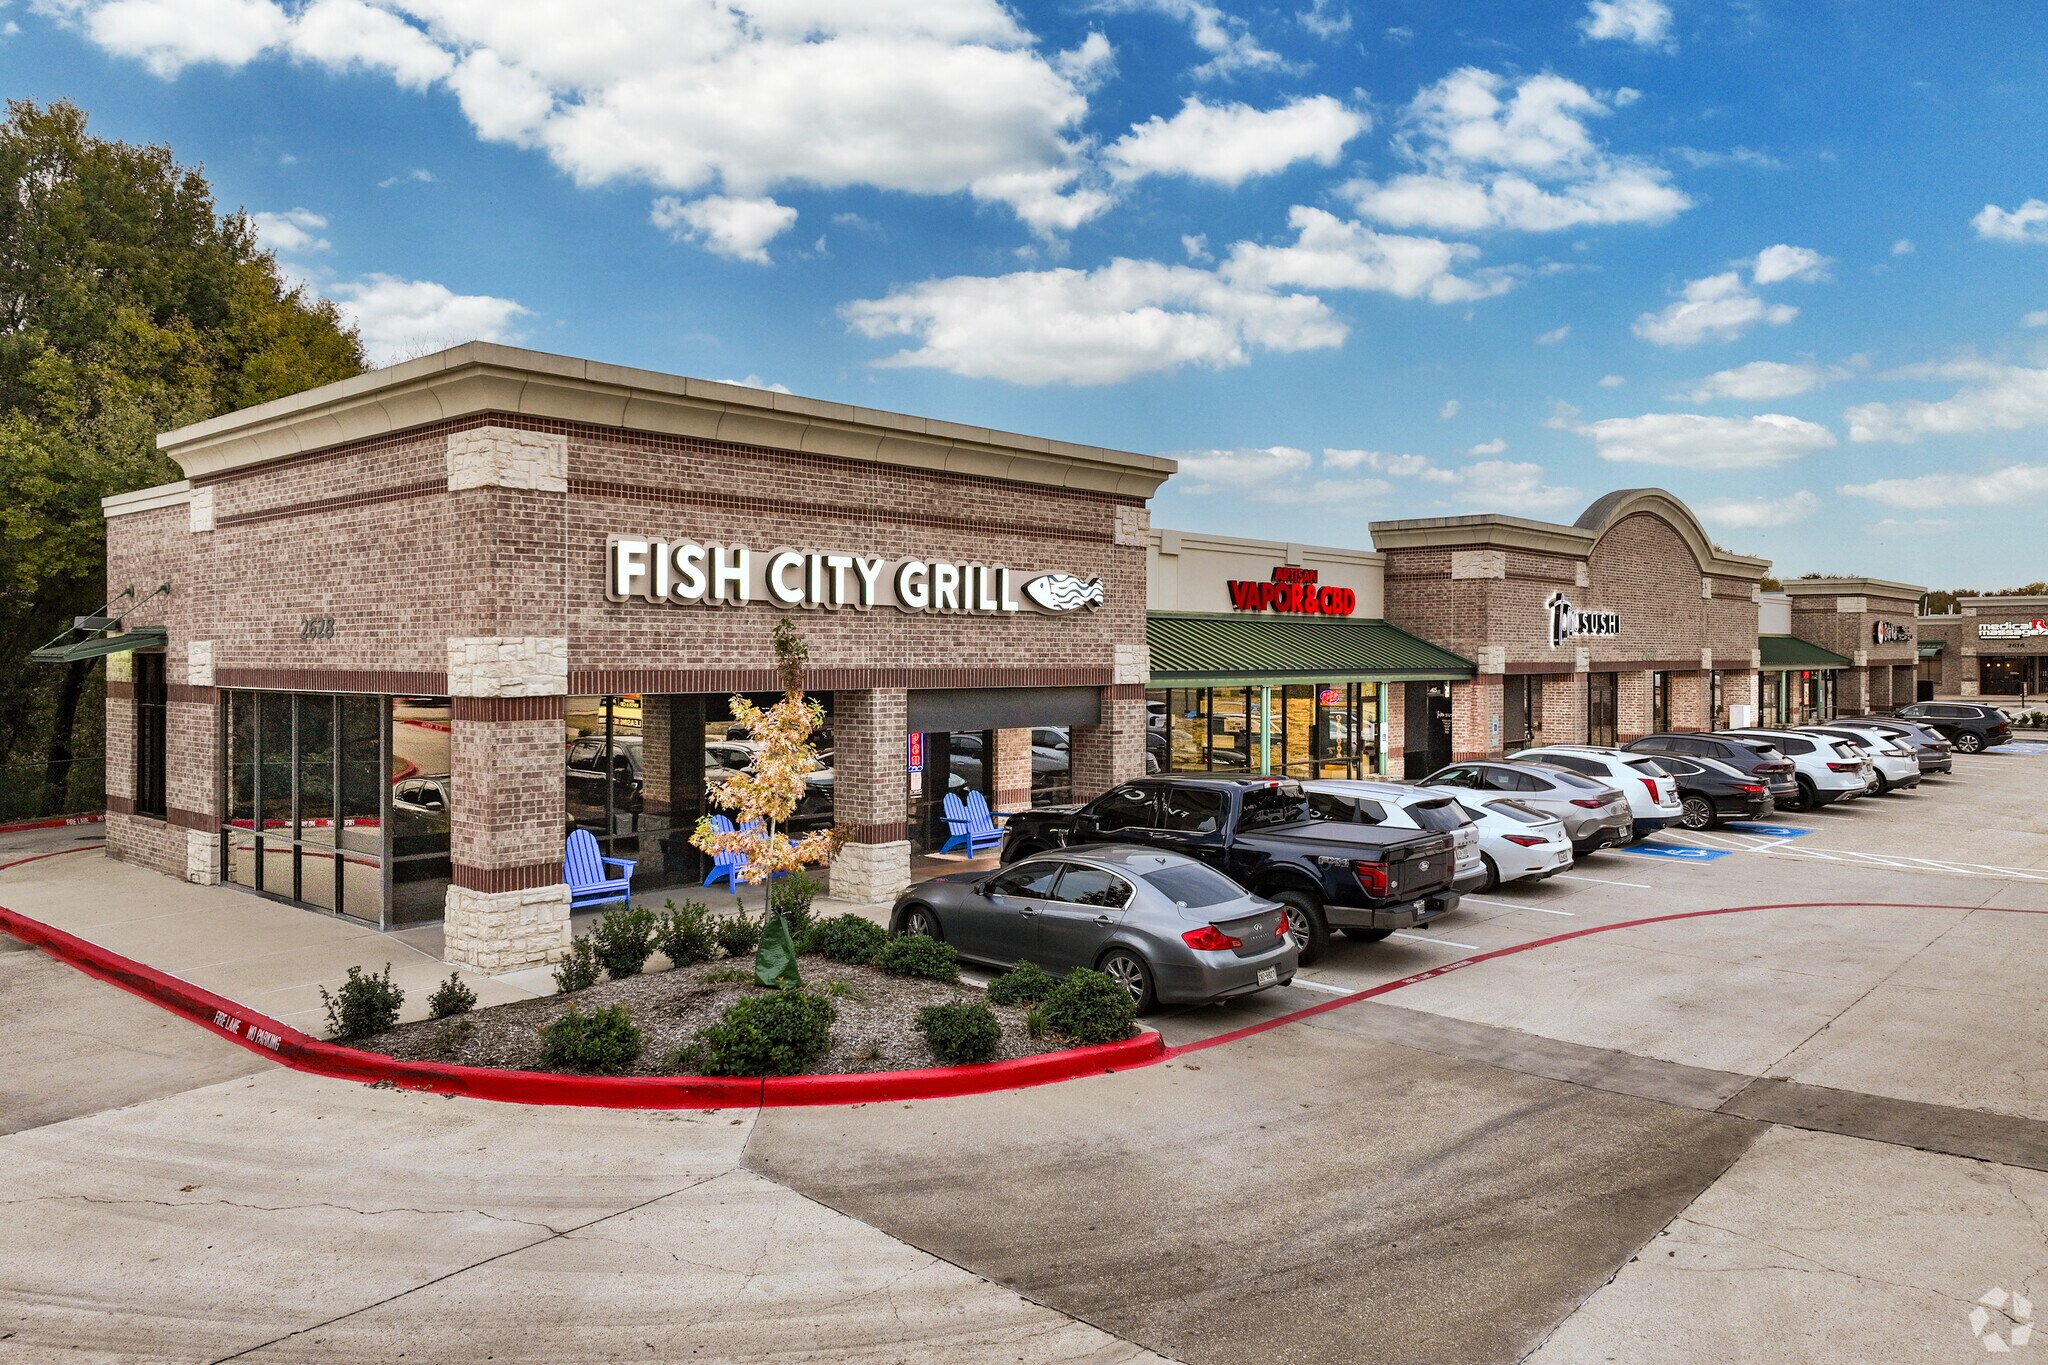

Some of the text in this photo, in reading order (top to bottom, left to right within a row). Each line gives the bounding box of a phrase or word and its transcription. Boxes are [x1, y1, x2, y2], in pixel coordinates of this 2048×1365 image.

[612, 540, 1019, 612] FISH CITY GRILL
[1271, 567, 1318, 583] ARTISAN
[301, 616, 335, 640] 2628
[1582, 613, 1621, 633] SUSHI
[1979, 621, 2032, 629] medical
[1978, 629, 2039, 637] massage
[1318, 855, 1350, 868] FX4
[213, 1010, 281, 1051] FIRE LANE NO PARKING
